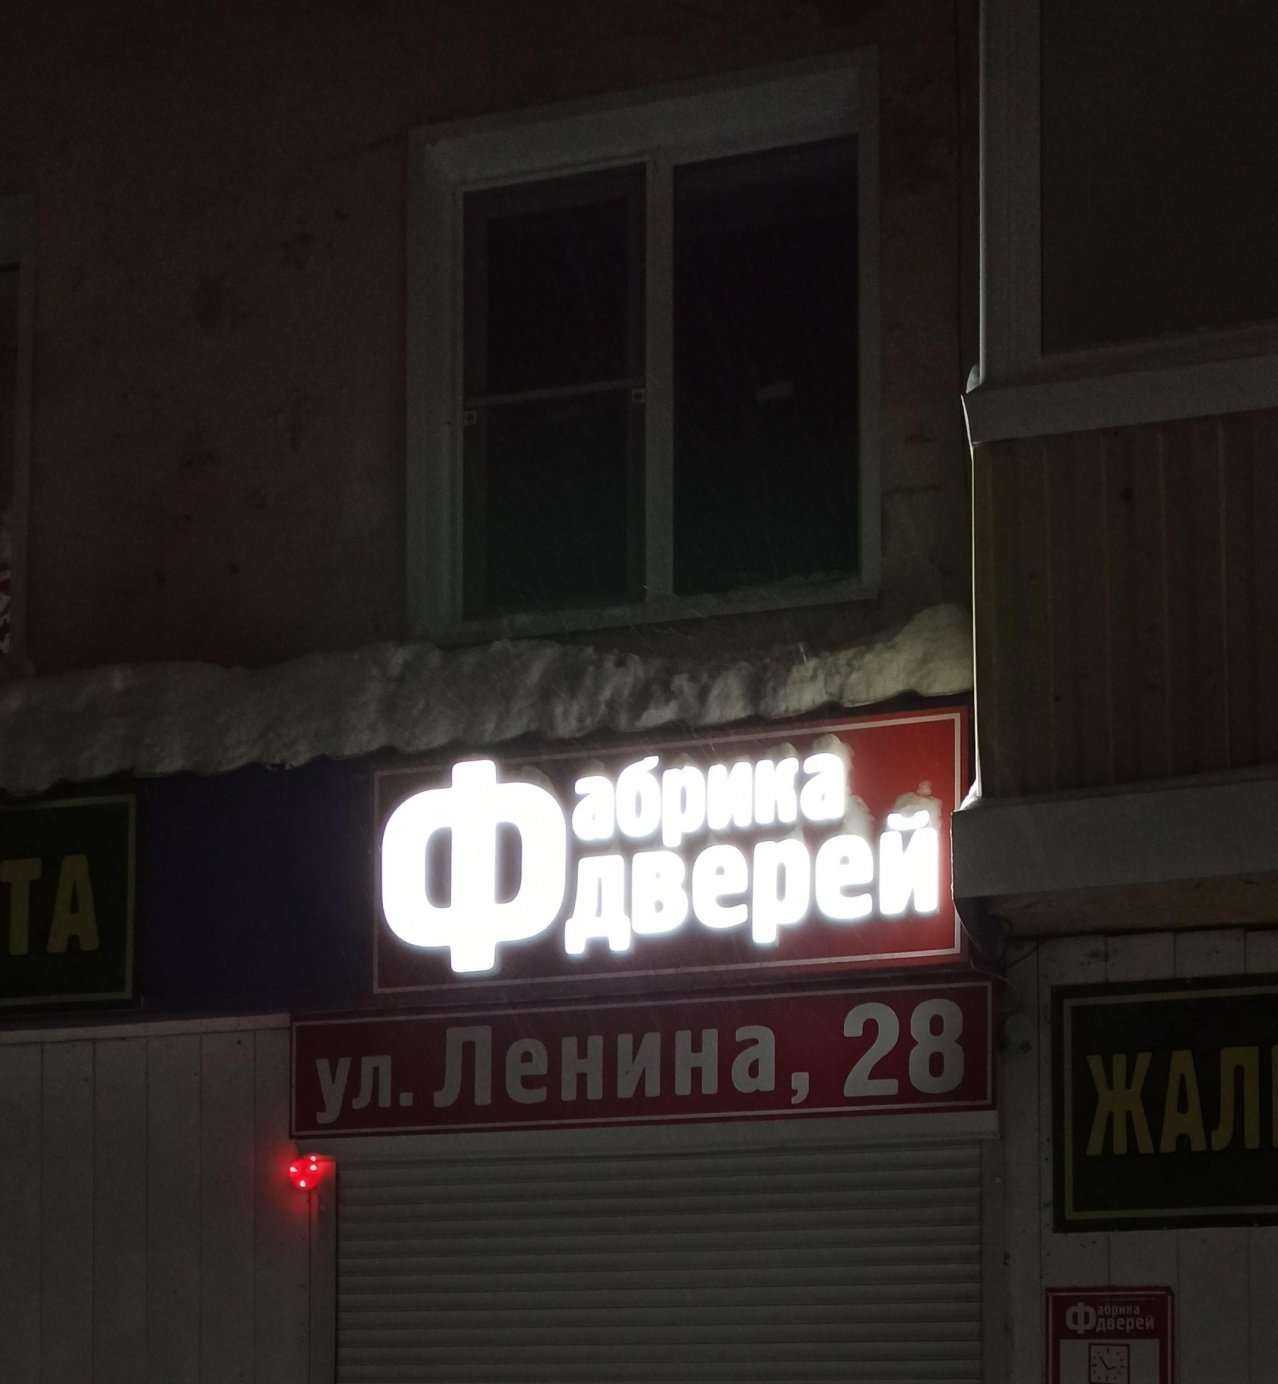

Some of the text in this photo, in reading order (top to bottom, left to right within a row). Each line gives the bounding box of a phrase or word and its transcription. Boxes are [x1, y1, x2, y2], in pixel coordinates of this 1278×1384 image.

[382, 752, 846, 972] Фабрика
[564, 812, 940, 955] дверей
[315, 998, 965, 1125] ул. Ленина, 28
[1096, 1313, 1155, 1334] дверей
